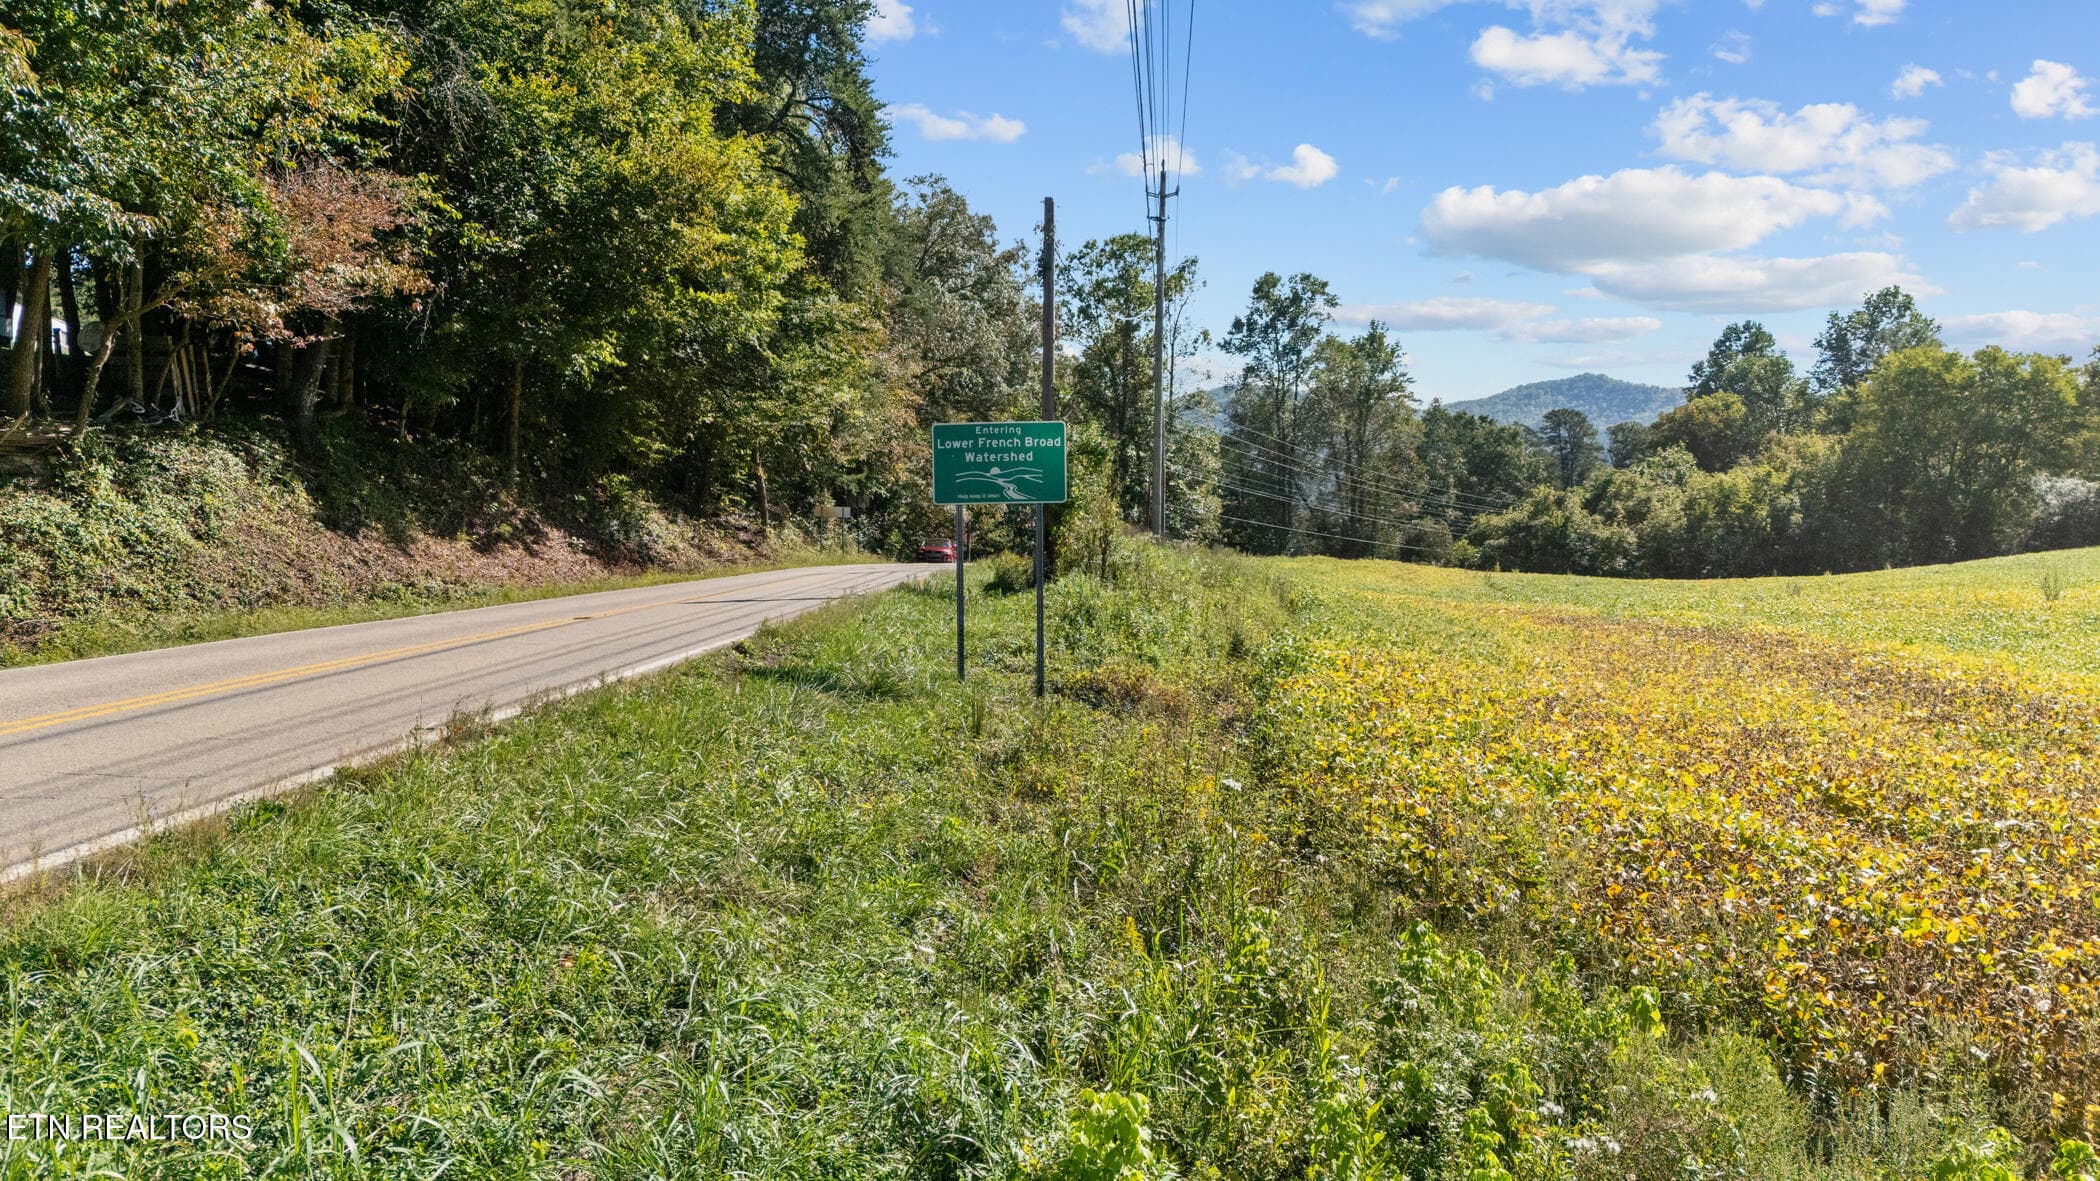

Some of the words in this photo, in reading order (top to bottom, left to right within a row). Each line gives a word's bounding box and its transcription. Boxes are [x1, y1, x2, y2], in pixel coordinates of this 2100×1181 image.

[975, 426, 1021, 435] Entering
[937, 439, 974, 449] Lower
[978, 437, 1021, 448] French
[1024, 436, 1061, 447] Broad
[965, 451, 1033, 462] Watershed
